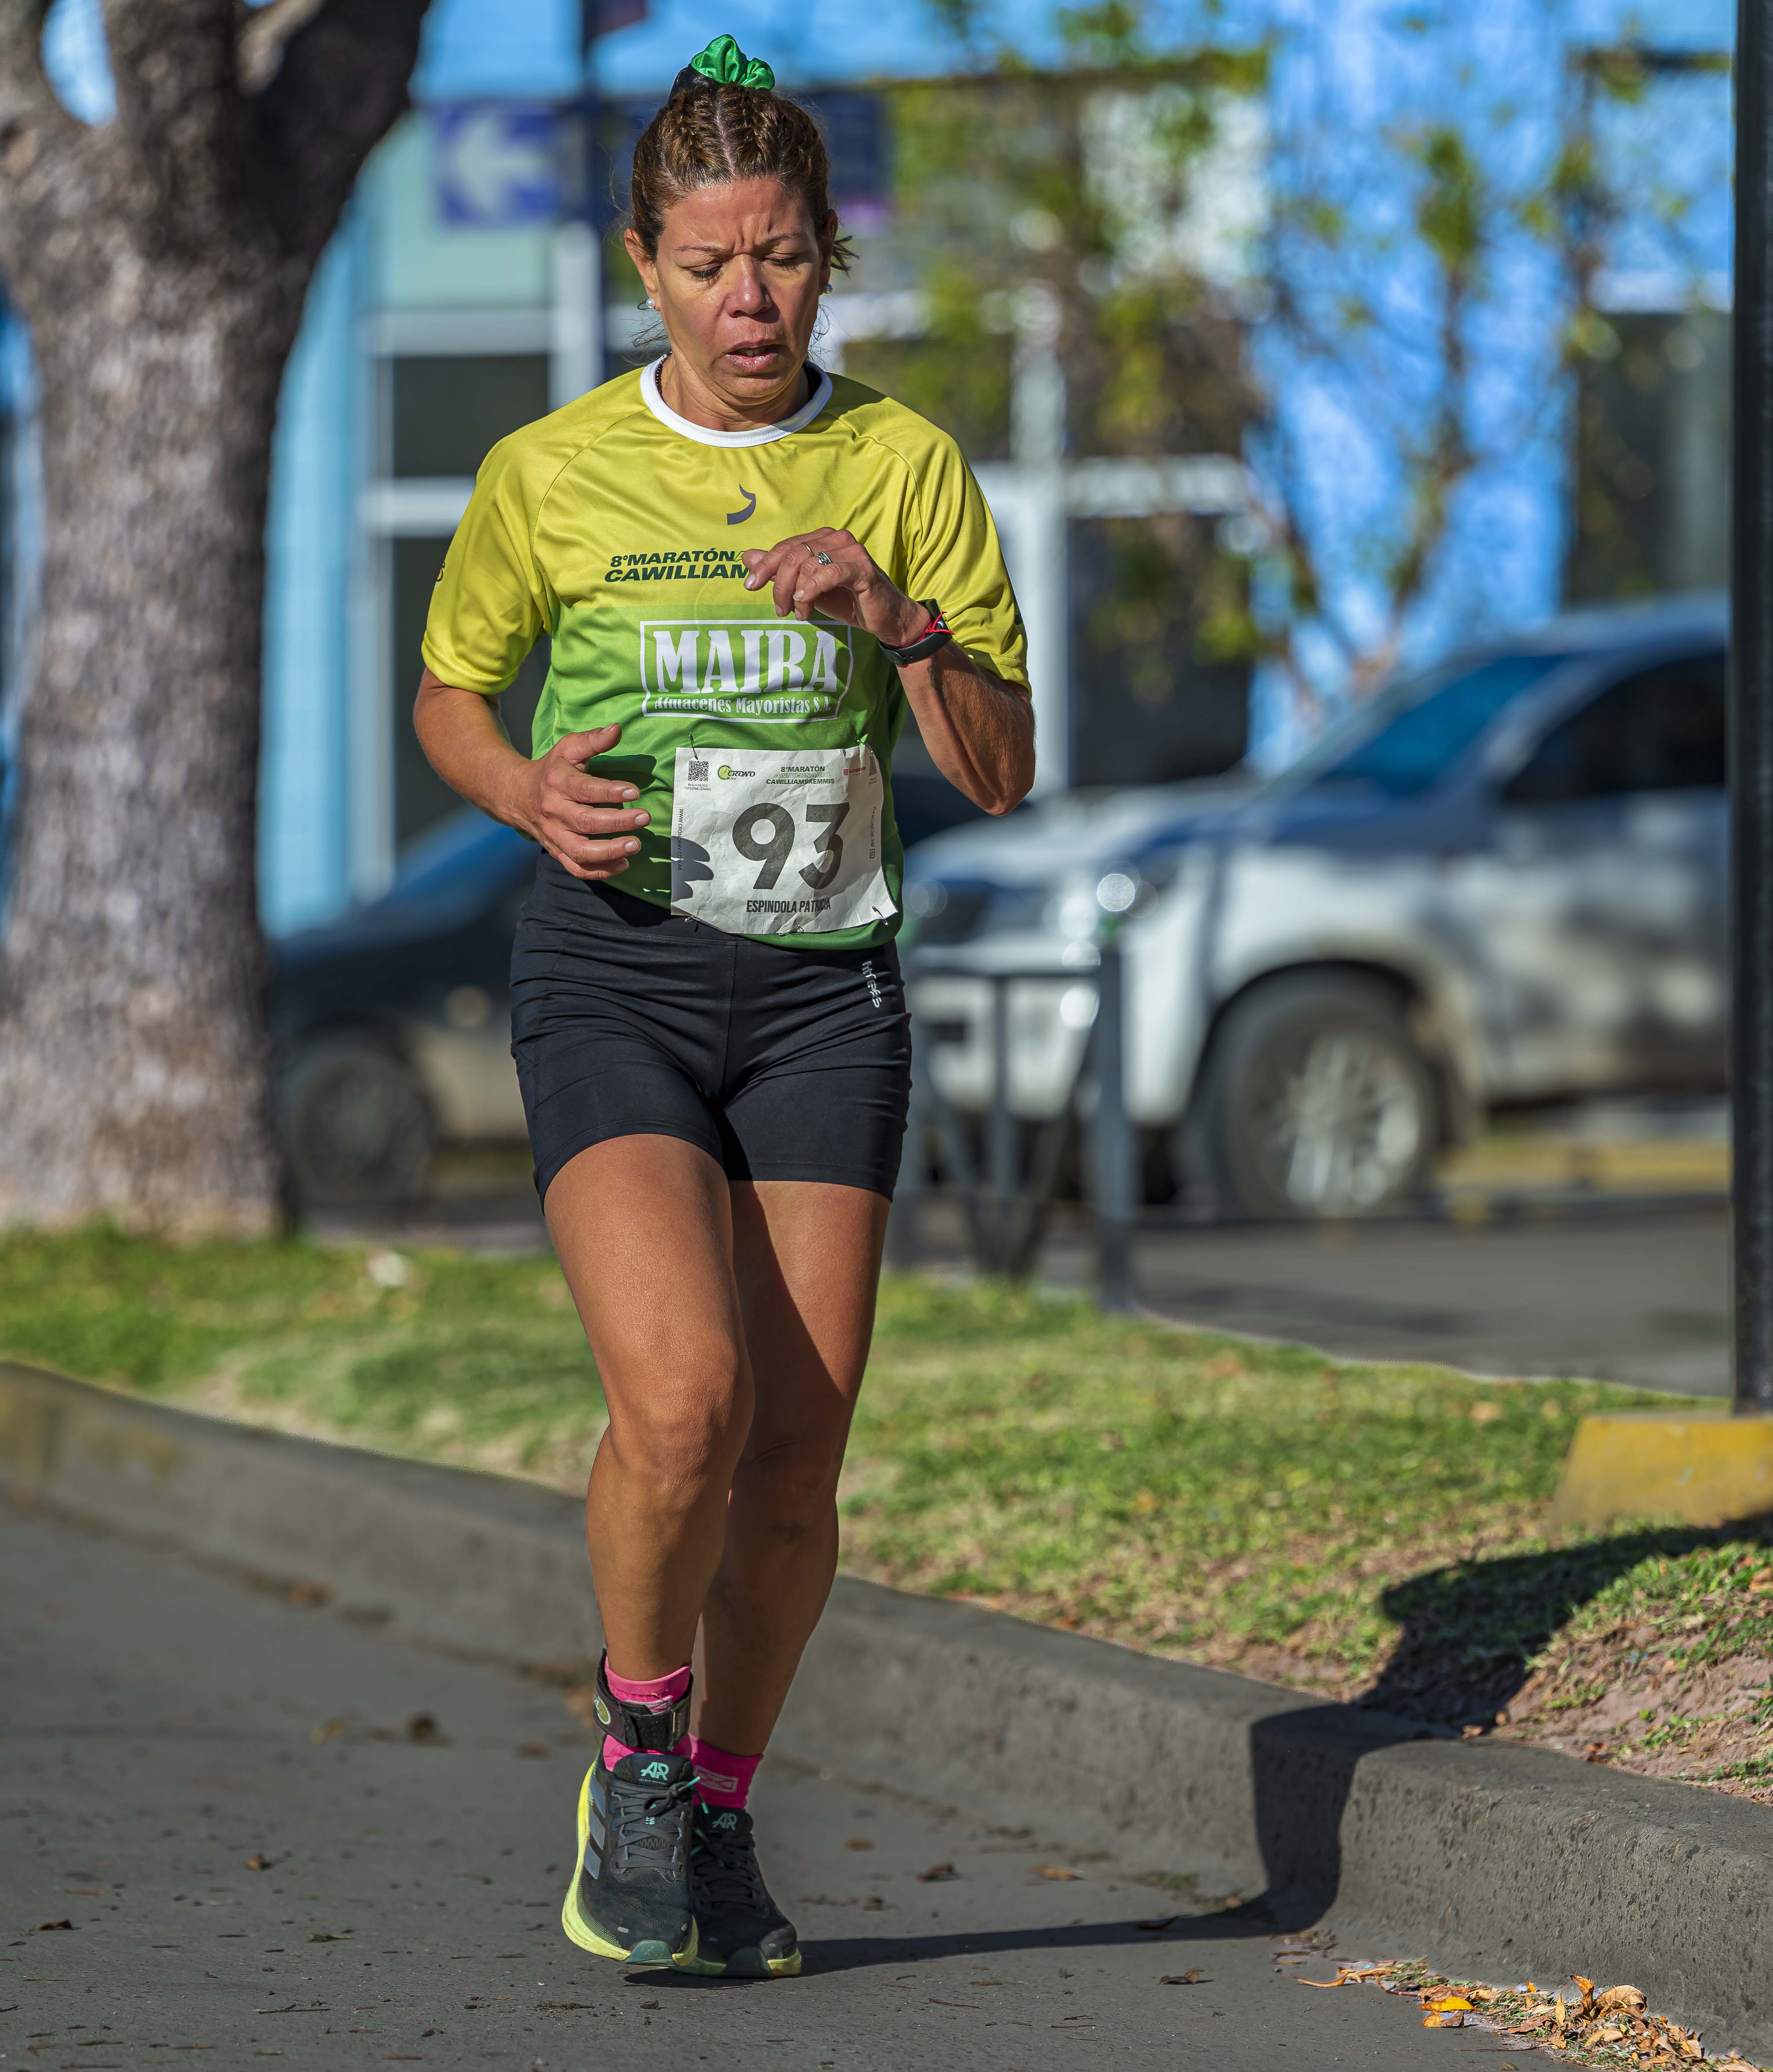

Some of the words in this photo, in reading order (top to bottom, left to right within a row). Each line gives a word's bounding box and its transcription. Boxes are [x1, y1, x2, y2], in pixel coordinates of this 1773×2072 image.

[604, 564, 749, 582] CAWILLIAM
[653, 630, 837, 693] MAIRA
[654, 697, 732, 713] Almacenes
[736, 697, 810, 715] Mayoristas
[732, 802, 850, 890] 93
[747, 900, 797, 913] ESPINDOLA
[640, 1762, 669, 1780] AR
